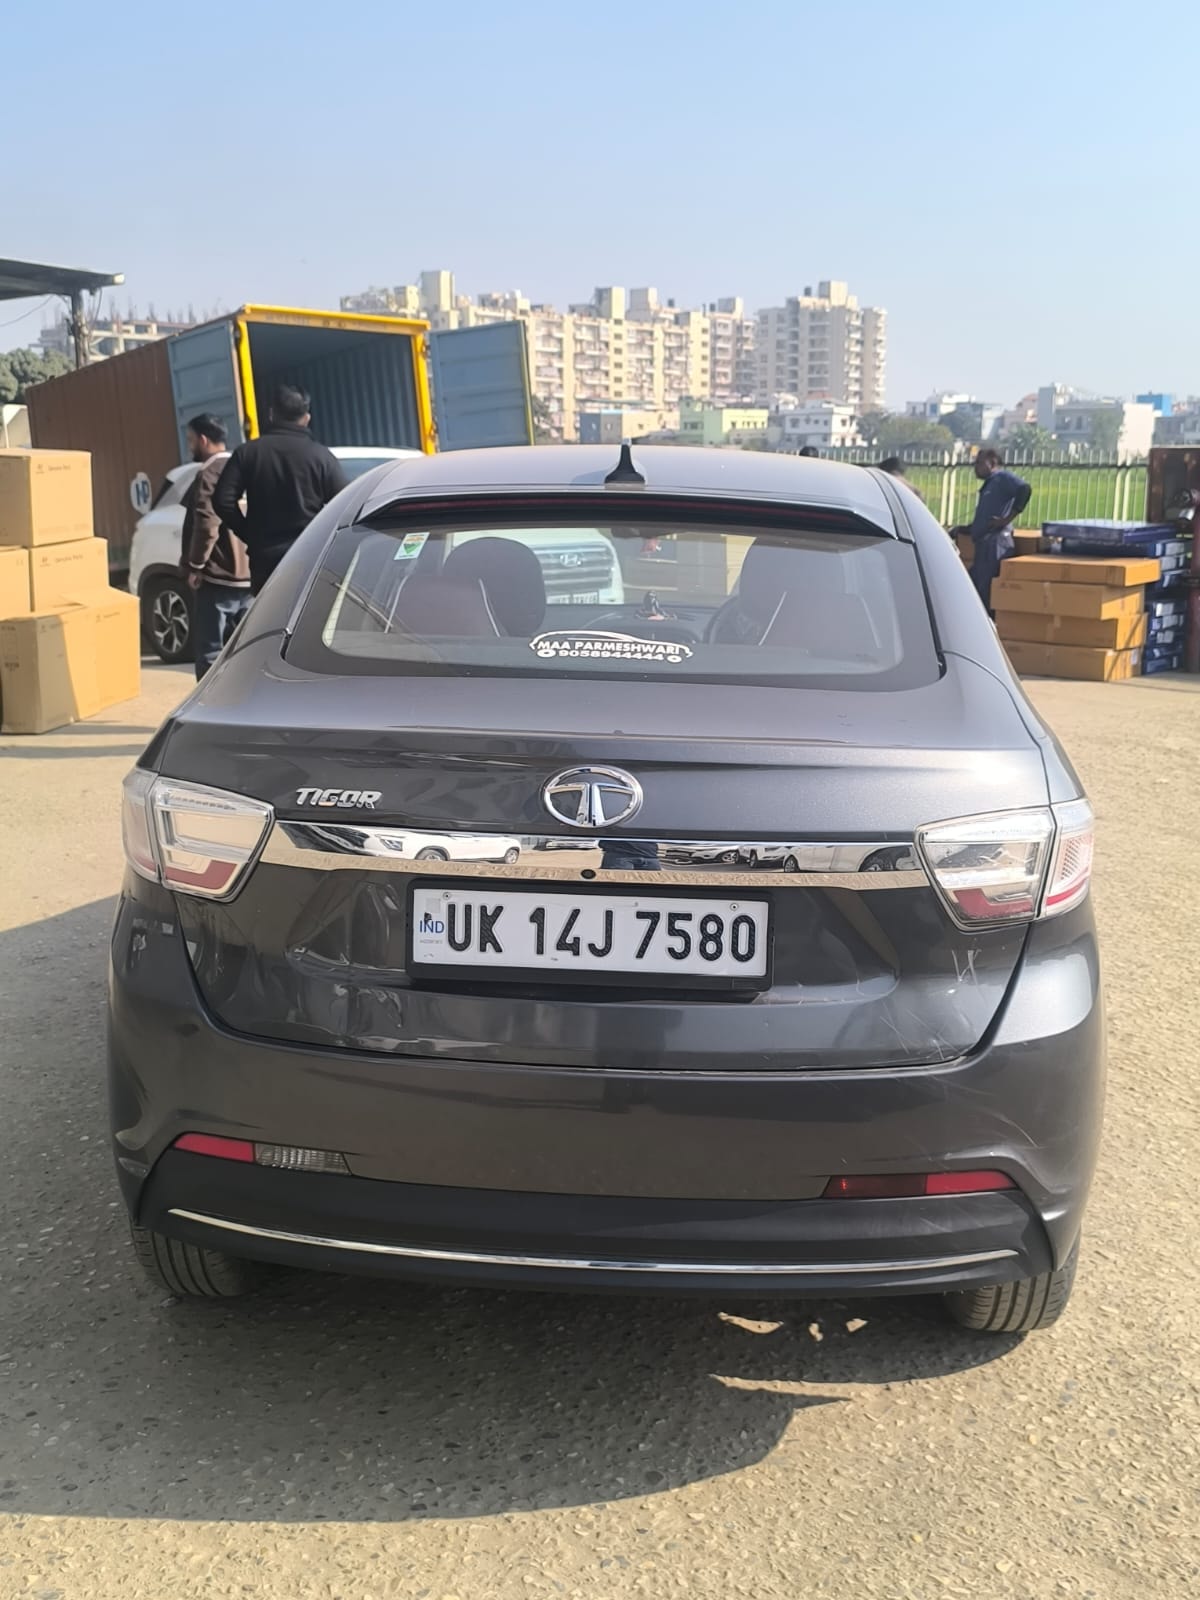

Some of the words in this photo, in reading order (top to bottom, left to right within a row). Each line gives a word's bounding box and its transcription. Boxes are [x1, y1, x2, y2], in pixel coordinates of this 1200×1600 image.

[537, 641, 571, 651] MAA
[575, 641, 680, 655] PARMESHWARI
[558, 649, 665, 661] 9058944444
[295, 787, 383, 810] TIGOR
[419, 920, 445, 934] IND
[447, 903, 504, 953] UK
[529, 907, 614, 958] 14J
[635, 911, 756, 963] 7580
